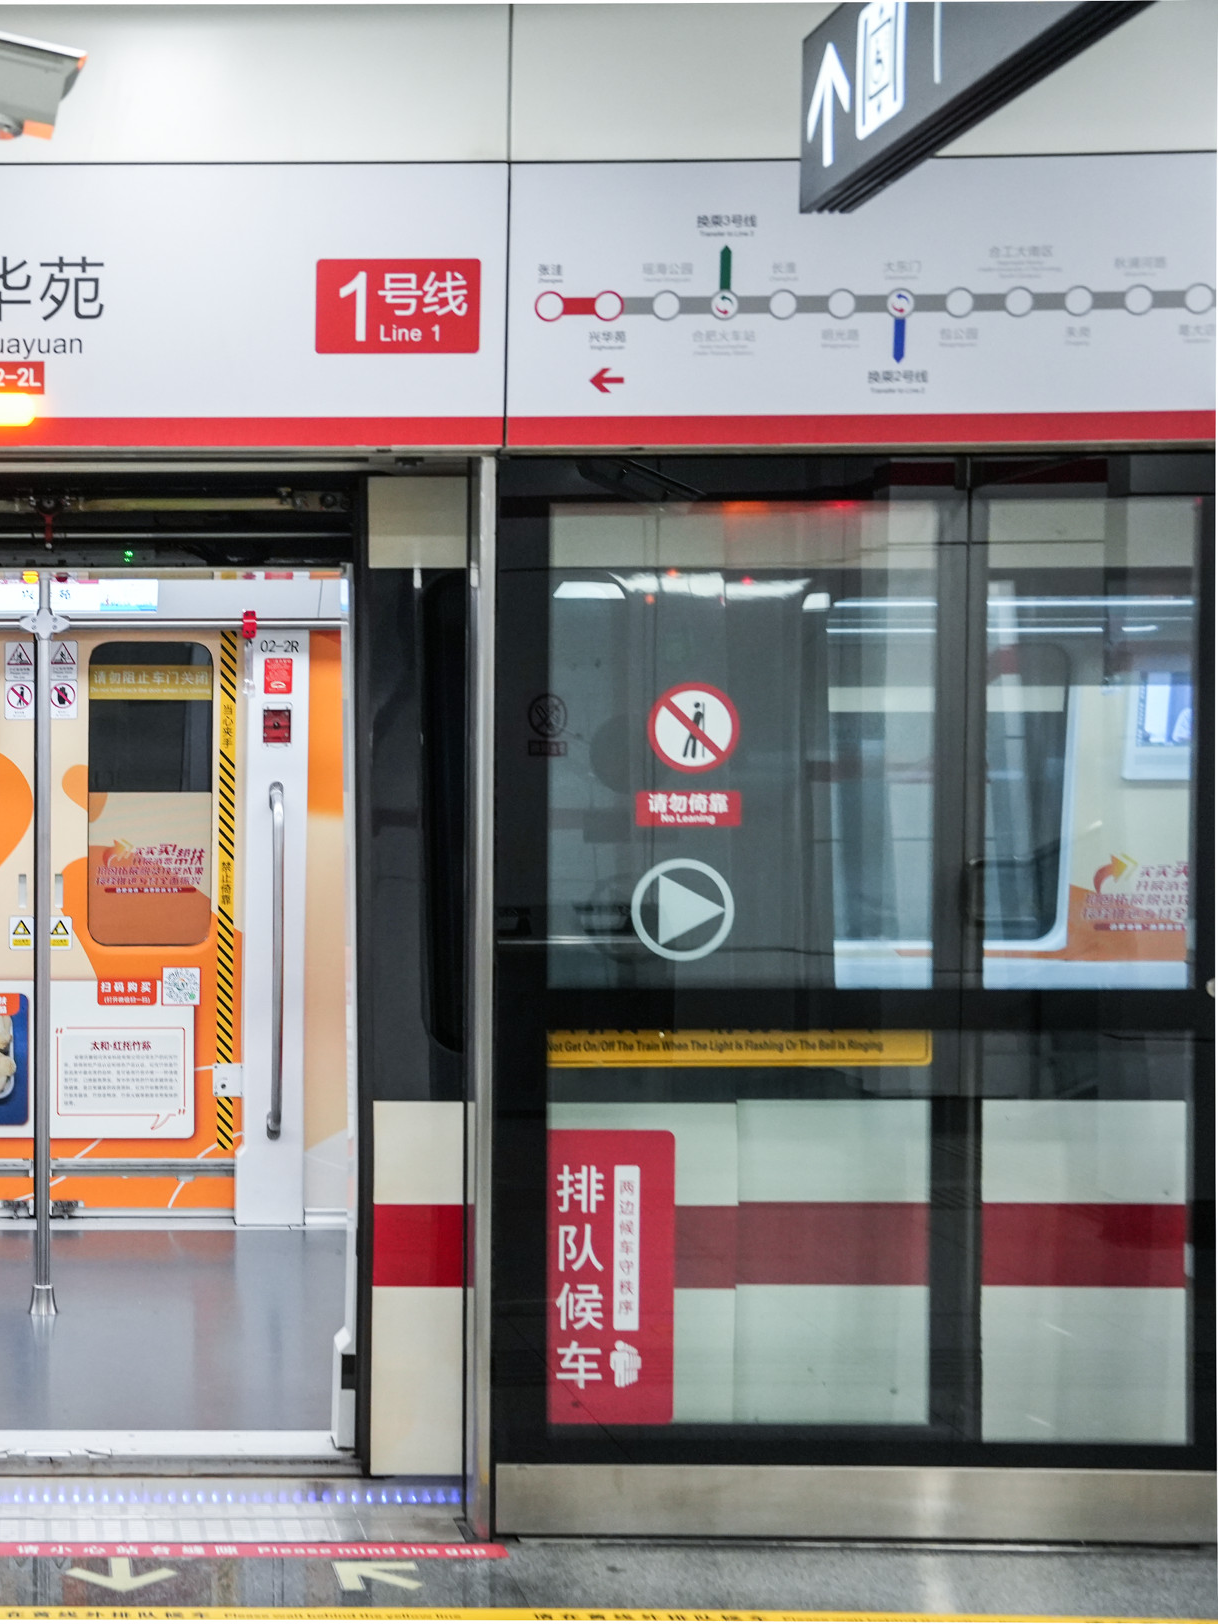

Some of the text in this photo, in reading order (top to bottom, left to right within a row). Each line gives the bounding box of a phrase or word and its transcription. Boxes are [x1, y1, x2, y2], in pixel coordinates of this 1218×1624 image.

[339, 270, 469, 343] 1号线
[379, 324, 441, 343] Line 1
[260, 640, 299, 653] 02-2R
[93, 670, 209, 685] 请勿阻止车门关闭
[648, 792, 728, 814] 请勿倚靠
[660, 813, 716, 825] No Leaning
[220, 861, 232, 905] 禁止倚靠
[100, 981, 152, 993] 扫码购买
[565, 1040, 581, 1052] Get
[617, 1040, 634, 1052] The
[636, 1040, 660, 1052] Train
[661, 1040, 688, 1052] When
[691, 1040, 708, 1052] The
[710, 1040, 733, 1053] Light
[745, 1039, 783, 1053] Flashing
[786, 1039, 797, 1051] Or
[799, 1039, 817, 1051] The
[818, 1039, 836, 1051] Bell
[848, 1039, 883, 1053] Ringing
[618, 1179, 636, 1316] 两边候车守秩序
[555, 1164, 605, 1390] 排队候车
[257, 1545, 487, 1557] Please mind the gap
